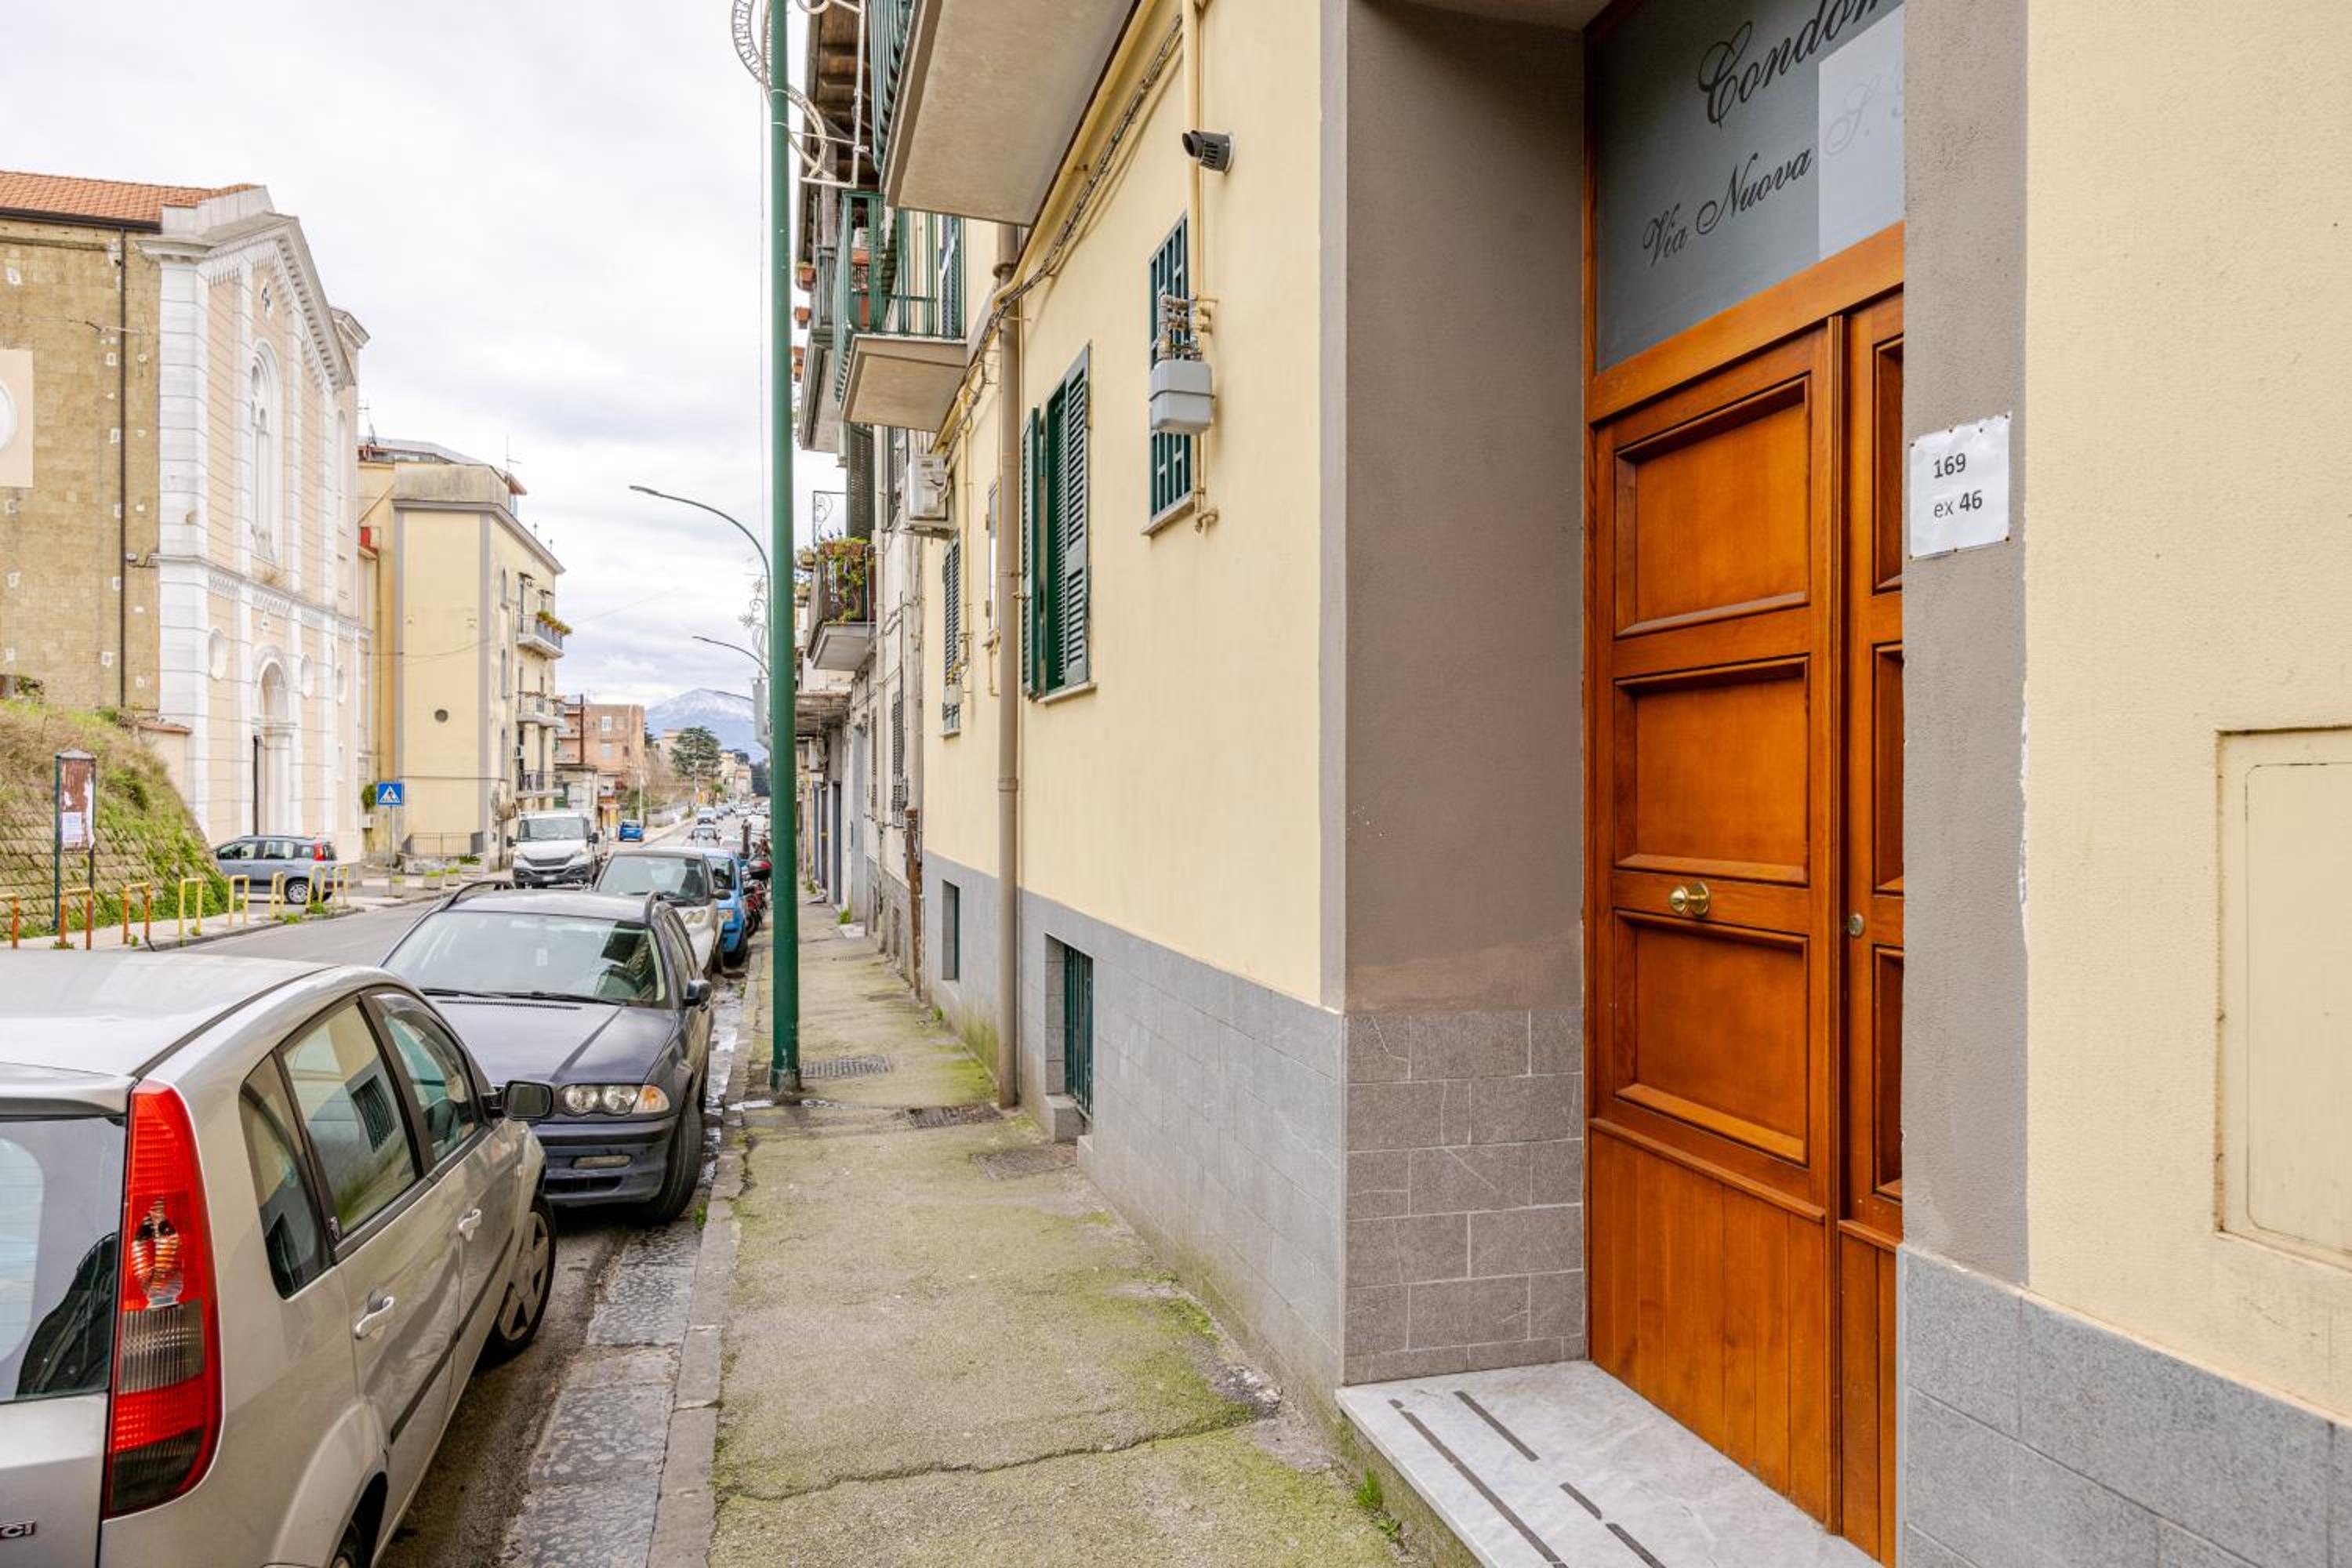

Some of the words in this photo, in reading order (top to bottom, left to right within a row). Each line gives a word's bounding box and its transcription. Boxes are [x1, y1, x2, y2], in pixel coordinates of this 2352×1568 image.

[1643, 202, 1687, 267] Via
[1696, 148, 1813, 235] Nuova
[1934, 452, 1966, 478] 169
[1934, 501, 1954, 518] ex
[1959, 490, 1983, 512] 46
